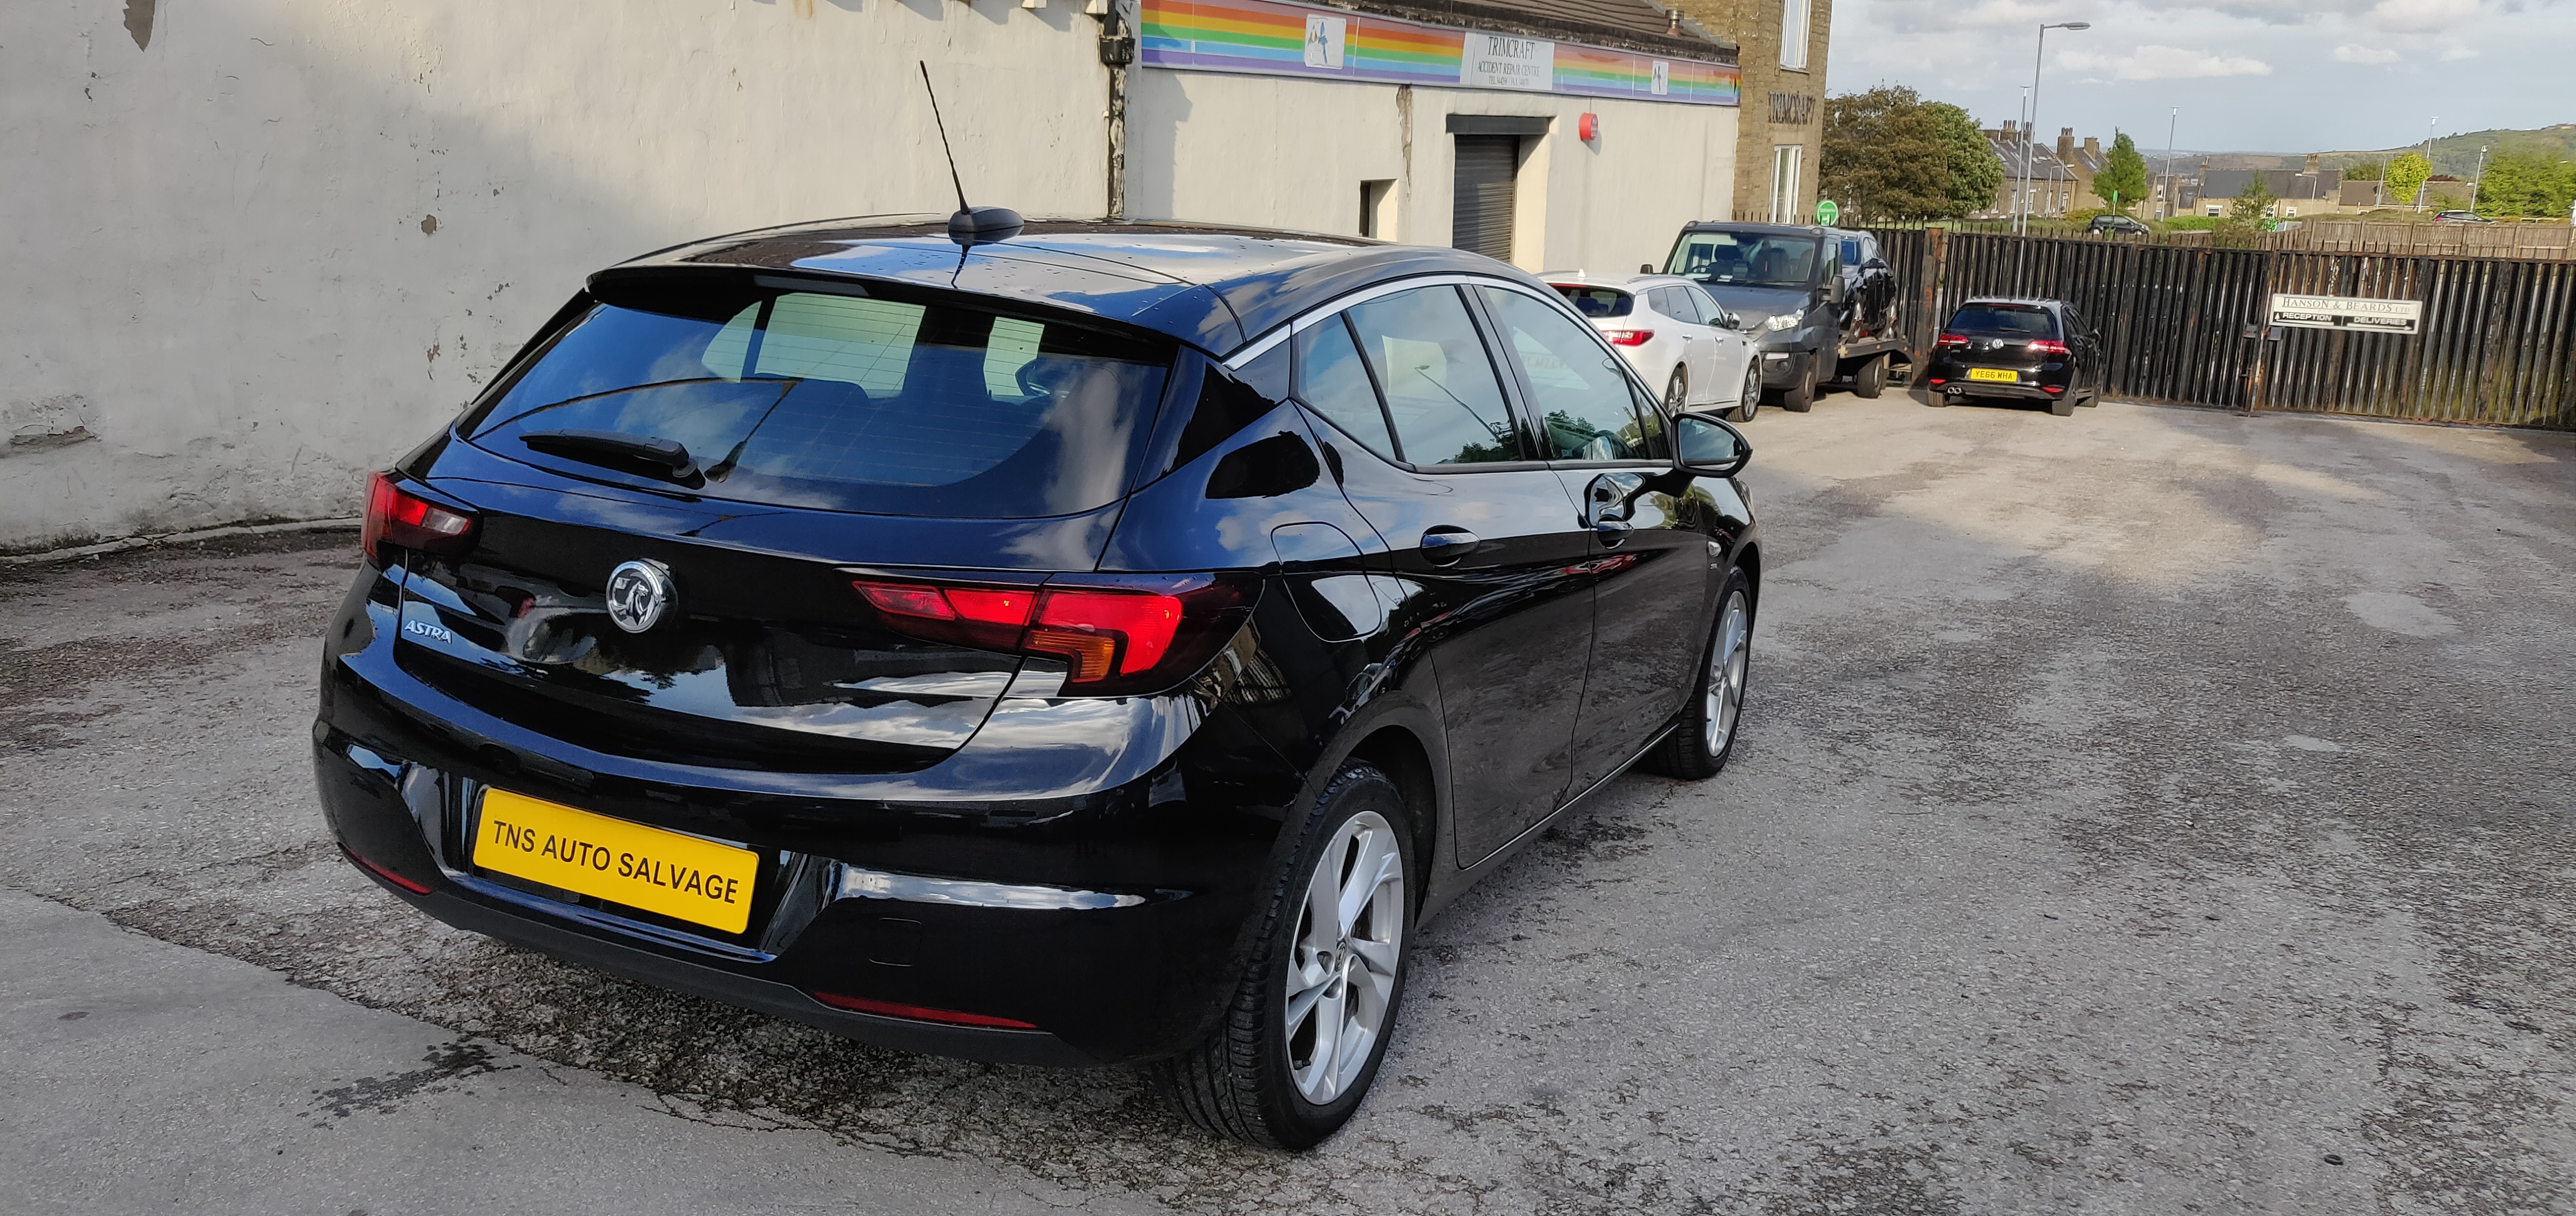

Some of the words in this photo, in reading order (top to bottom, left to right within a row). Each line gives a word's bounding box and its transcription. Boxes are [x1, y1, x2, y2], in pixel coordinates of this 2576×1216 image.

[1488, 36, 1535, 60] TRIMCRAFT
[1478, 61, 1503, 74] ACCIDENT
[1503, 63, 1521, 76] REPAIR
[1521, 65, 1540, 77] CENTRE
[2283, 298, 2329, 308] HANSON
[2333, 301, 2341, 309] &
[2347, 302, 2392, 312] BEARDS
[2283, 312, 2332, 321] RECEPTION
[2354, 317, 2407, 326] DELIVERIES
[1975, 370, 1995, 378] YE66
[404, 619, 452, 644] ASTRA
[493, 819, 536, 852] TNS
[541, 834, 610, 871] AUTO
[618, 852, 739, 904] SALVAGE
